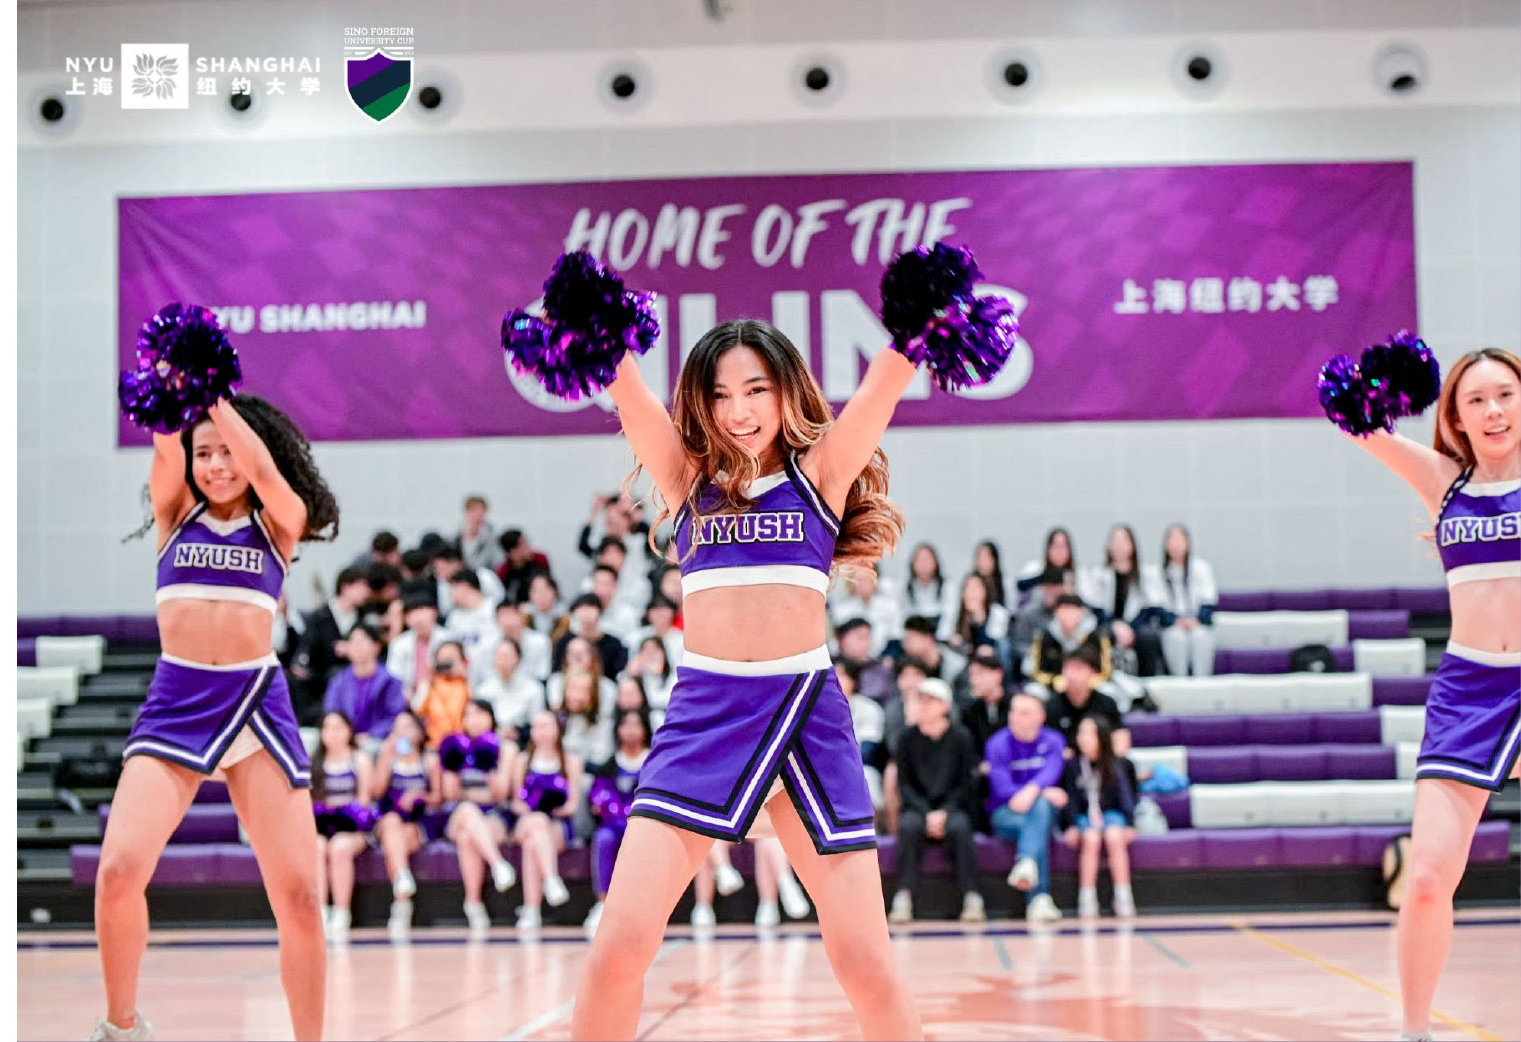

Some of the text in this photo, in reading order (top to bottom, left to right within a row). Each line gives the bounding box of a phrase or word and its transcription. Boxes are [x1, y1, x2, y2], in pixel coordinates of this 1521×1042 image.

[563, 197, 973, 271] HOME OF THE
[210, 300, 427, 334] YU SHANGHAI
[690, 511, 805, 546] NYUSH
[1440, 511, 1521, 547] NYUS
[173, 542, 264, 575] NYUSH
